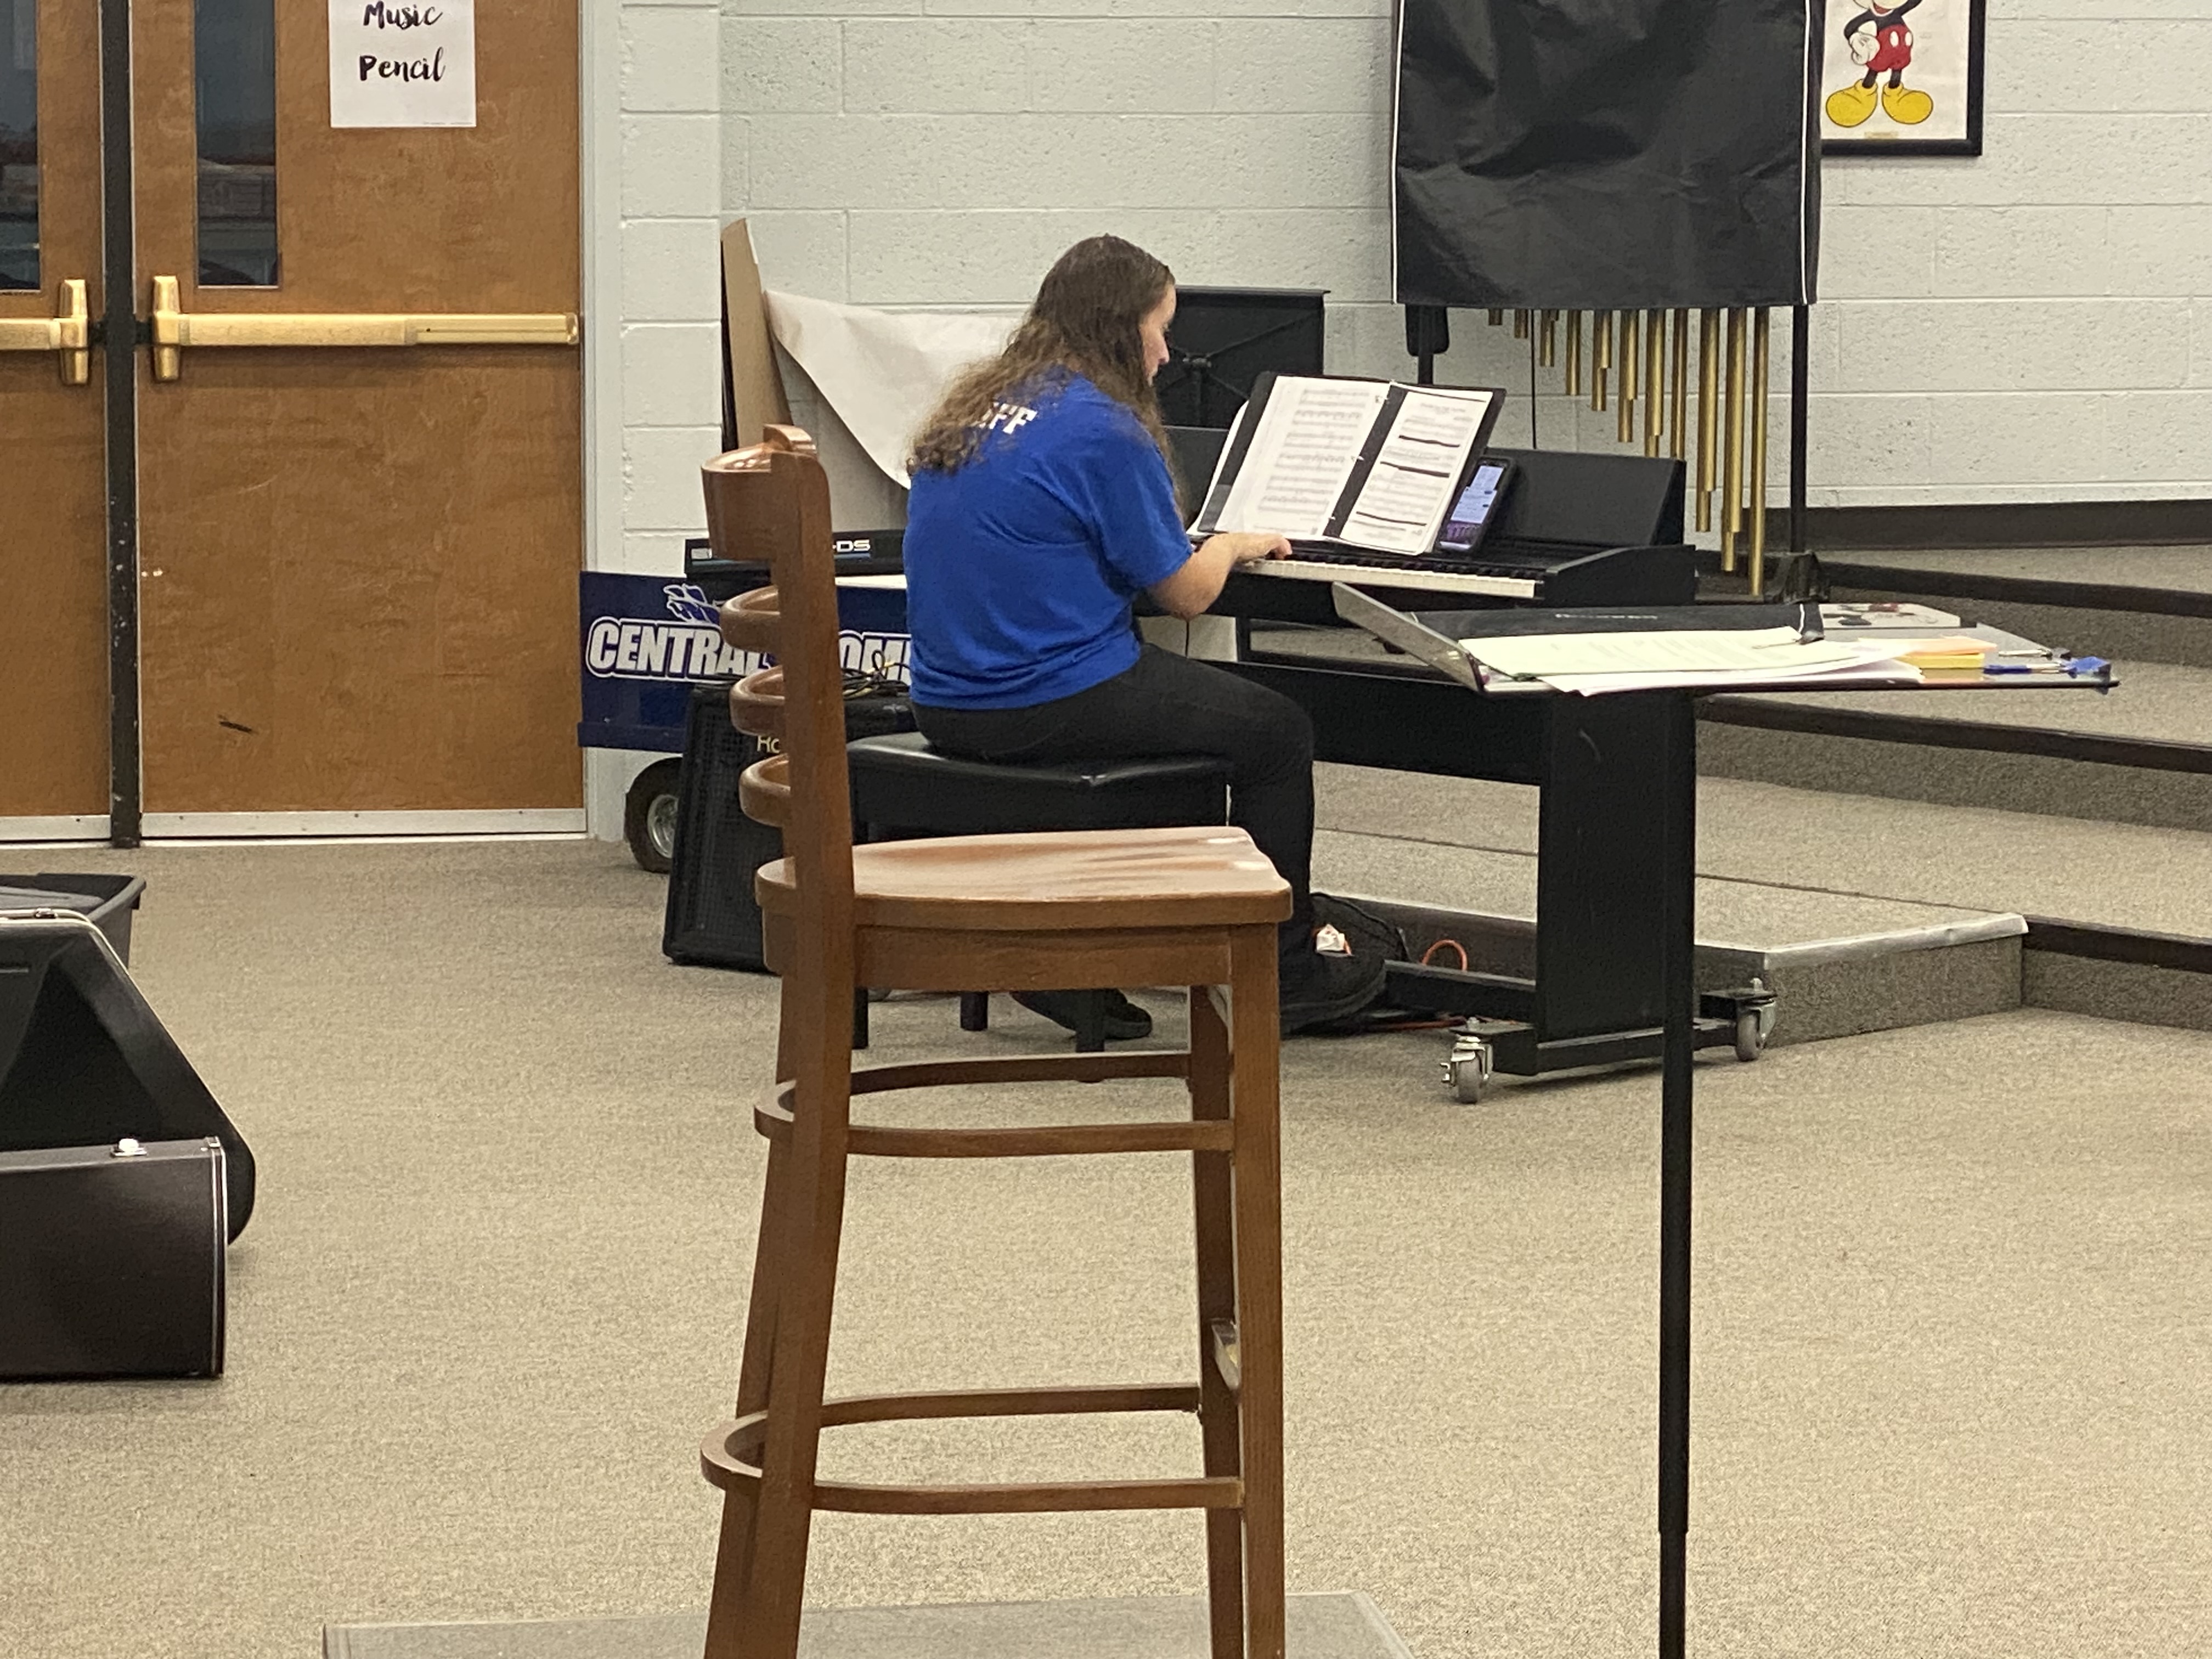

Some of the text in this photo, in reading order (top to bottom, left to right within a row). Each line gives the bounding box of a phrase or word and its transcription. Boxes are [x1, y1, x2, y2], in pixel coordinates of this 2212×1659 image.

[363, 1, 443, 30] Music
[359, 46, 446, 82] Pencil
[589, 622, 769, 677] CENTRAL
